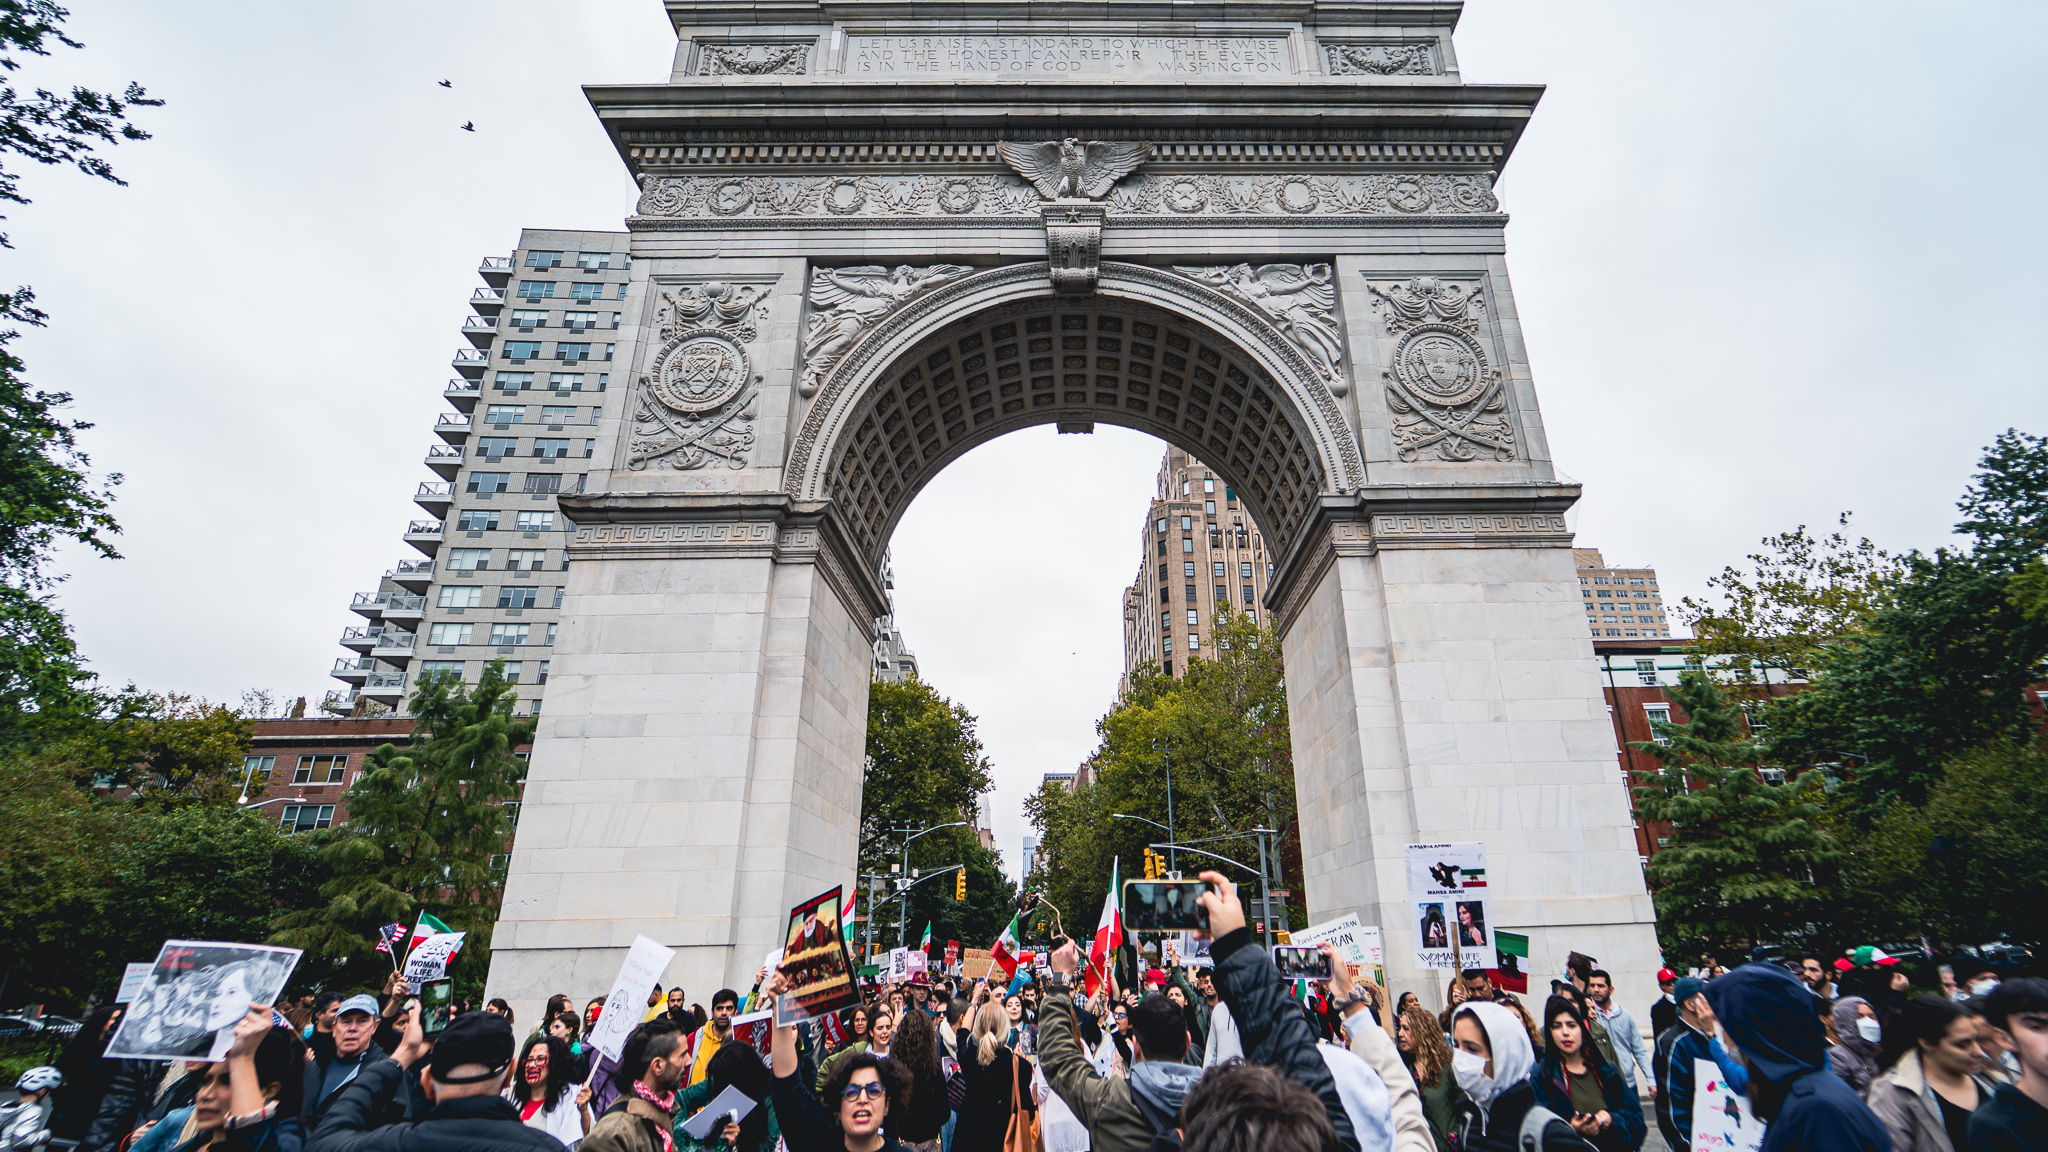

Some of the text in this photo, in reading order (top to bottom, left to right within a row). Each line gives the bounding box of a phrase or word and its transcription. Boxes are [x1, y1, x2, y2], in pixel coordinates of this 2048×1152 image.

[859, 38, 1278, 49] LET US RAISE A STANDARD TO WHICH THE WISE
[857, 50, 1279, 60] AND THE HONEST CAN REPAIR THE EVENT
[857, 61, 1281, 71] IS IN THE HAND OF GOD WASHINGTON
[1342, 920, 1358, 929] IRAN
[1417, 953, 1459, 961] WOMAN
[411, 960, 441, 969] WOMAN
[415, 968, 432, 977] LIFE
